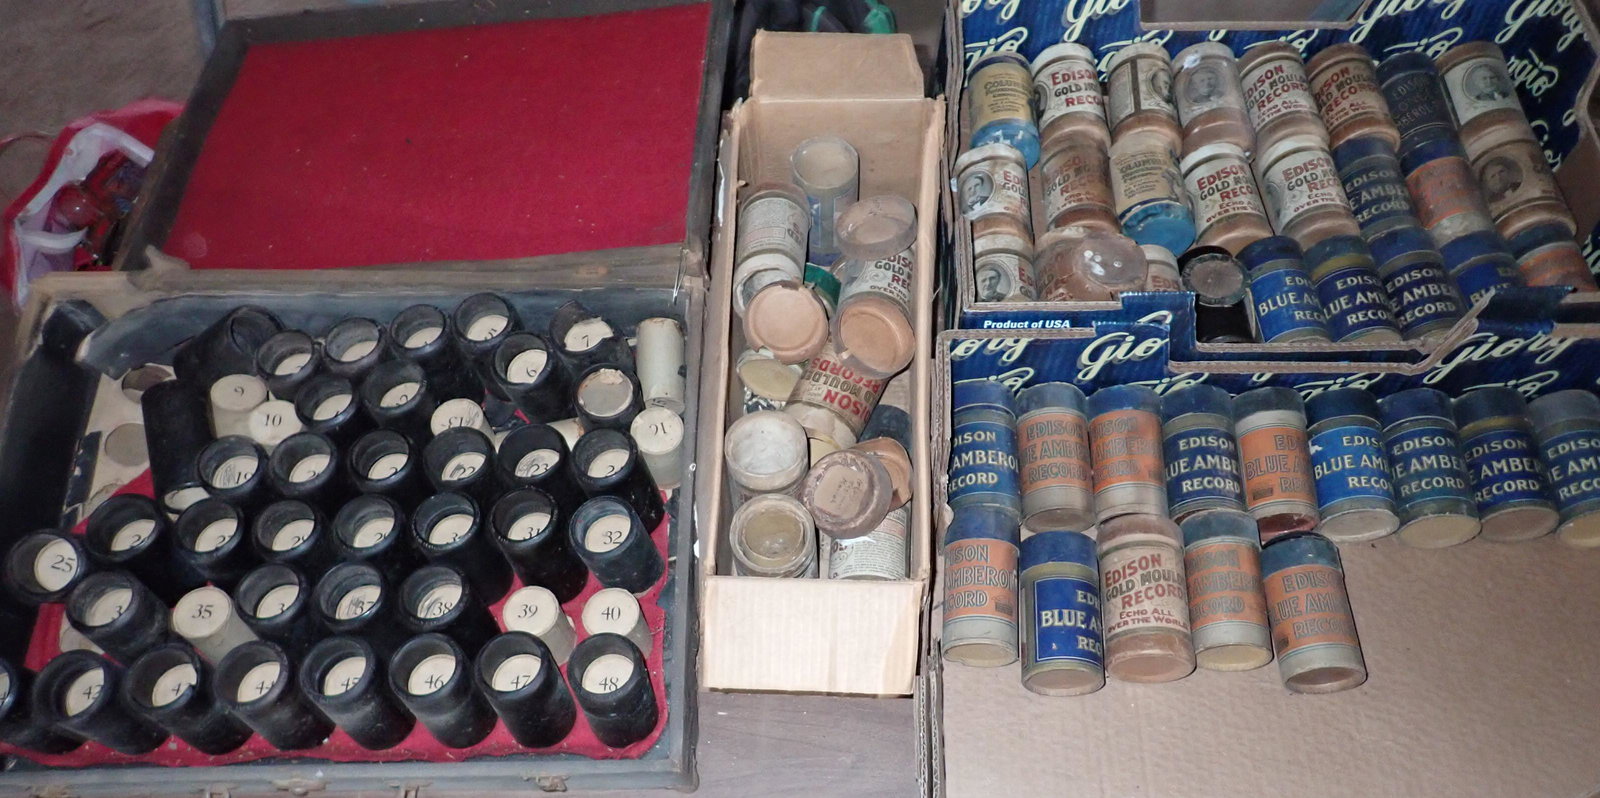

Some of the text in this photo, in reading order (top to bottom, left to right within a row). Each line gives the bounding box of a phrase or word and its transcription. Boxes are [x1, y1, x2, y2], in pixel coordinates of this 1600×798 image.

[1054, 83, 1082, 97] GOLD
[1287, 172, 1318, 191] GOLD
[1200, 180, 1230, 201] GOLD
[874, 260, 905, 276] GOLD
[1259, 292, 1300, 316] BLUE
[983, 320, 1070, 329] Product of USA
[581, 335, 591, 348] 7
[526, 367, 537, 379] 6
[234, 386, 244, 397] 9
[263, 413, 282, 428] 10
[1179, 435, 1235, 451] EDISON
[1392, 436, 1455, 456] EDISON
[1464, 438, 1527, 462] EDISON
[1245, 454, 1291, 481] BLUE
[1314, 454, 1357, 480] BLUE
[1182, 476, 1241, 493] RECORD
[1400, 476, 1465, 497] RECORD
[1474, 479, 1540, 504] RECORD
[603, 530, 624, 545] 32
[51, 553, 76, 573] 25
[1104, 553, 1162, 589] EDISON
[1105, 579, 1136, 602] GOLD
[191, 604, 214, 619] 35
[432, 601, 453, 615] 38
[518, 603, 538, 619] 39
[601, 606, 621, 620] 40
[1041, 608, 1087, 629] BLUE
[425, 673, 444, 689] 46
[511, 674, 531, 689] 47
[599, 676, 619, 692] 48
